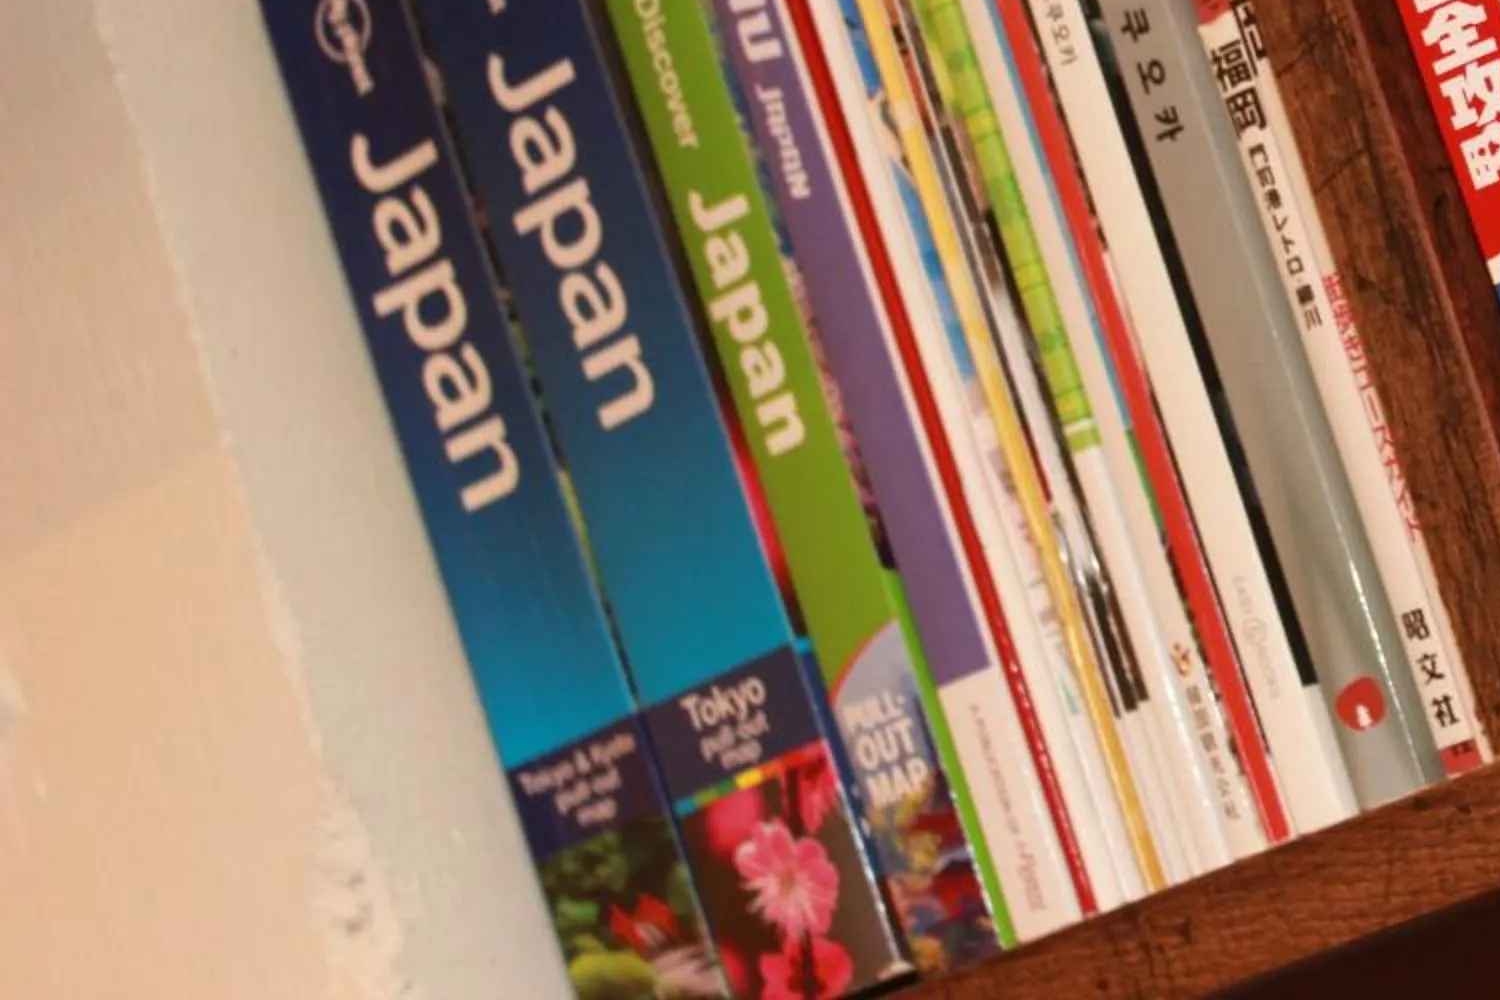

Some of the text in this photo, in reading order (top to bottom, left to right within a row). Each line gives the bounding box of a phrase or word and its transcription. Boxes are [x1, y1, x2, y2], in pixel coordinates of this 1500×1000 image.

[1211, 39, 1267, 140] 福岡
[487, 53, 654, 431] Japan
[350, 132, 519, 512] Japan
[687, 188, 807, 457] Japan
[680, 676, 766, 732] Tokyo
[1401, 608, 1461, 730] 昭文社
[854, 720, 917, 769] OUT
[866, 760, 930, 803] MAP
